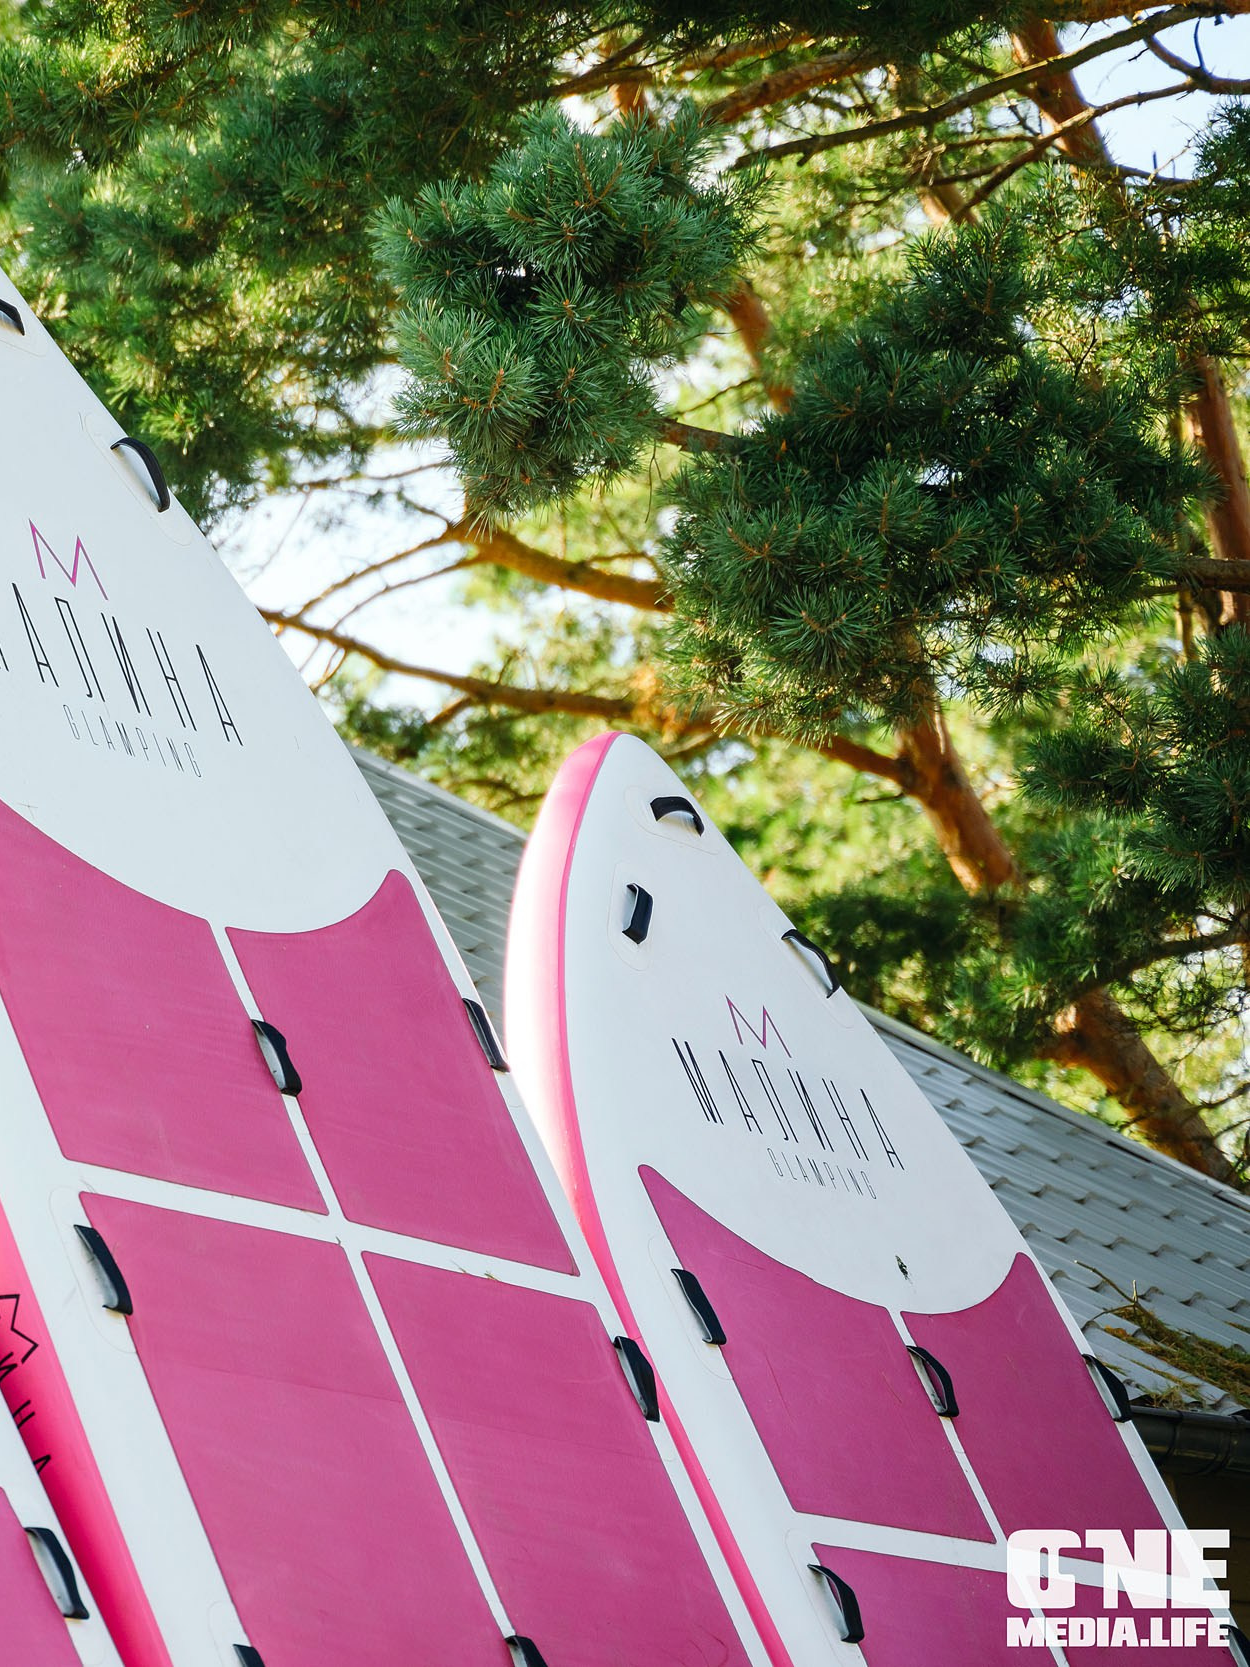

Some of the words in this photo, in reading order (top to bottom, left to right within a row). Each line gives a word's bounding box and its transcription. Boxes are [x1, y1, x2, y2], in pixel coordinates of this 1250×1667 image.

[62, 704, 202, 778] GLAMPING
[671, 1037, 905, 1170] МАЛИНА
[766, 1147, 877, 1200] GLAMPING
